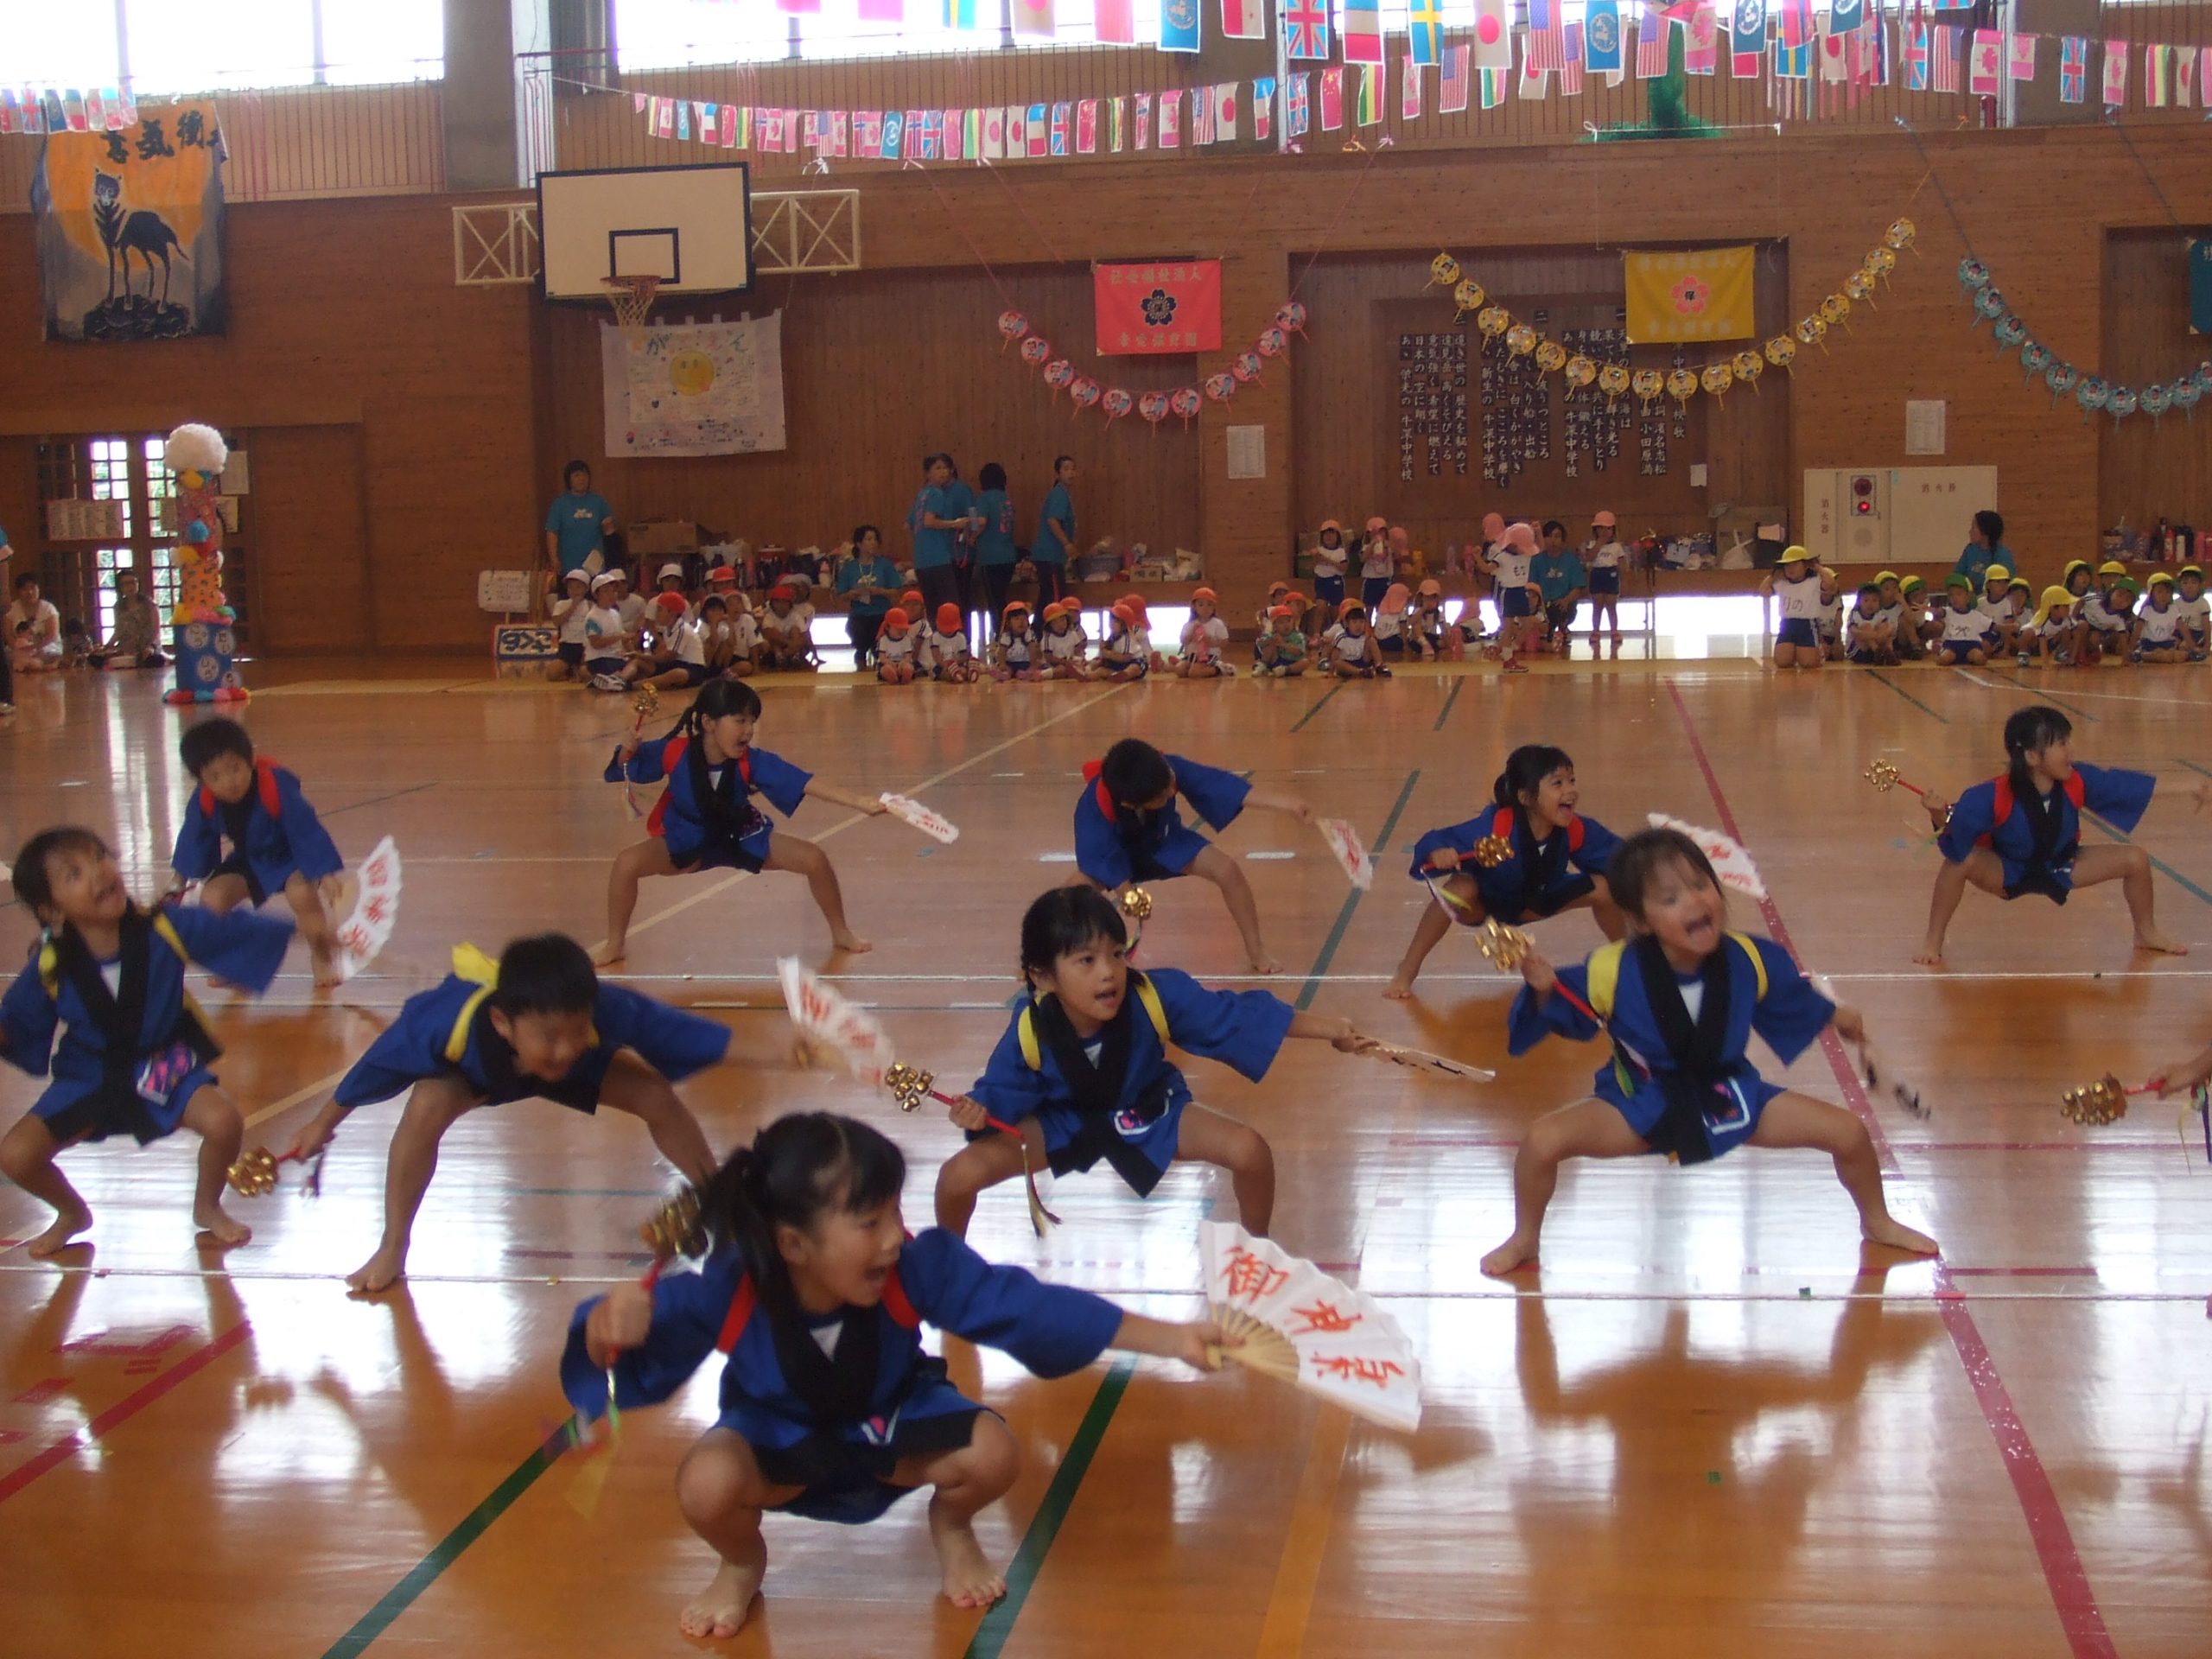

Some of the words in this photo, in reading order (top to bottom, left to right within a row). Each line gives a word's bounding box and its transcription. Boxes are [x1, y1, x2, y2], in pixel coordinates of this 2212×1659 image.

[1414, 335, 1426, 372] 日本の
[1400, 415, 1413, 483] 牛深中学校
[1482, 415, 1496, 480] 牛深中学校
[1921, 482, 1957, 494] 消火栓
[1821, 498, 1830, 534] 消火器
